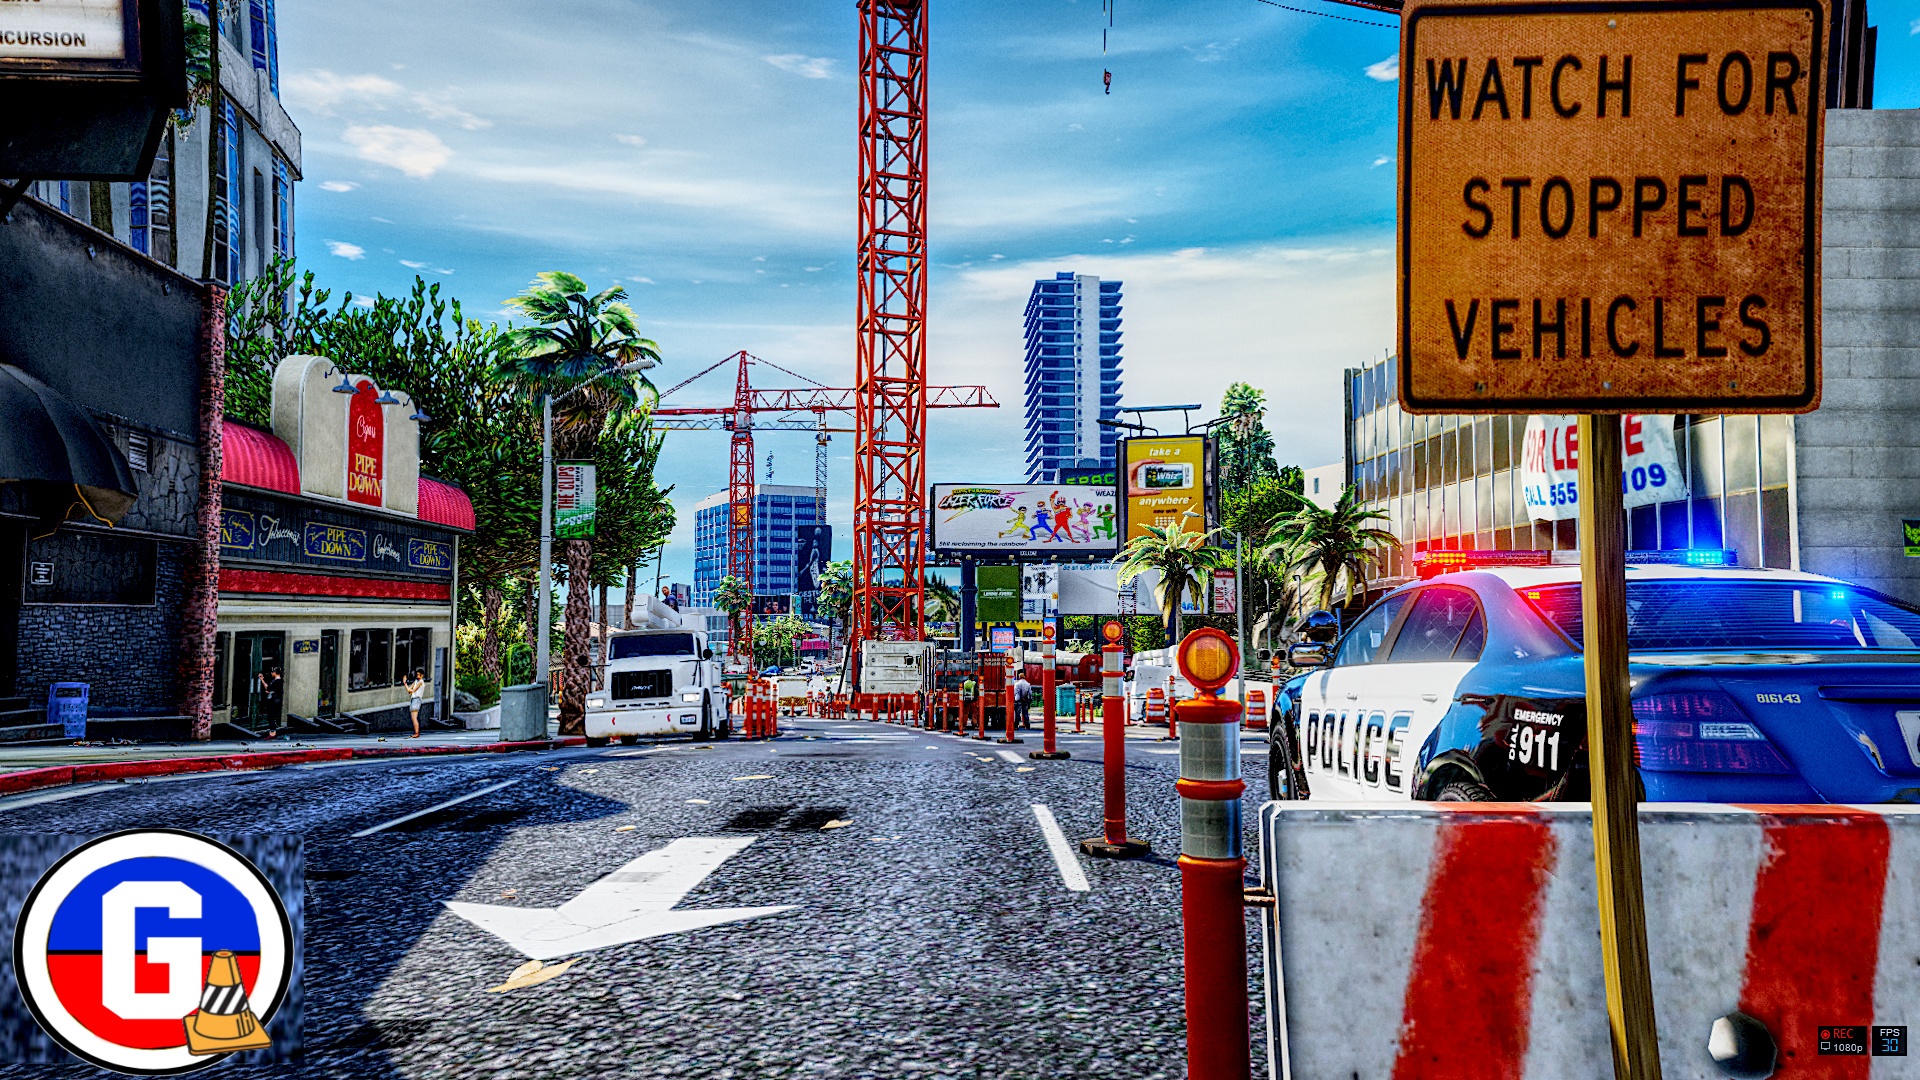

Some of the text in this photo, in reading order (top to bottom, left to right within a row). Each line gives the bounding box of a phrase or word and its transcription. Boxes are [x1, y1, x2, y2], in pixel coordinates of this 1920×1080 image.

[0, 30, 86, 47] CURSION
[1425, 51, 1803, 121] WATCH FOR
[1462, 175, 1756, 240] STOPPED
[1445, 294, 1773, 360] VEHICLES
[1149, 448, 1171, 456] take
[355, 453, 377, 477] PIPE
[1157, 471, 1178, 480] Whiz
[349, 472, 382, 498] DOWN
[558, 493, 574, 509] THE
[940, 494, 1012, 509] LAZER FORCE
[1139, 496, 1190, 507] anywhere
[327, 528, 347, 542] PIPE
[321, 540, 351, 556] DOWN
[423, 543, 438, 556] PIPE
[420, 553, 441, 567] DOWN
[1756, 693, 1801, 704] 816143
[1514, 708, 1564, 727] EMERGENCY
[1508, 723, 1519, 761] DIAL
[1518, 726, 1560, 772] 911
[1307, 709, 1414, 794] POLICE
